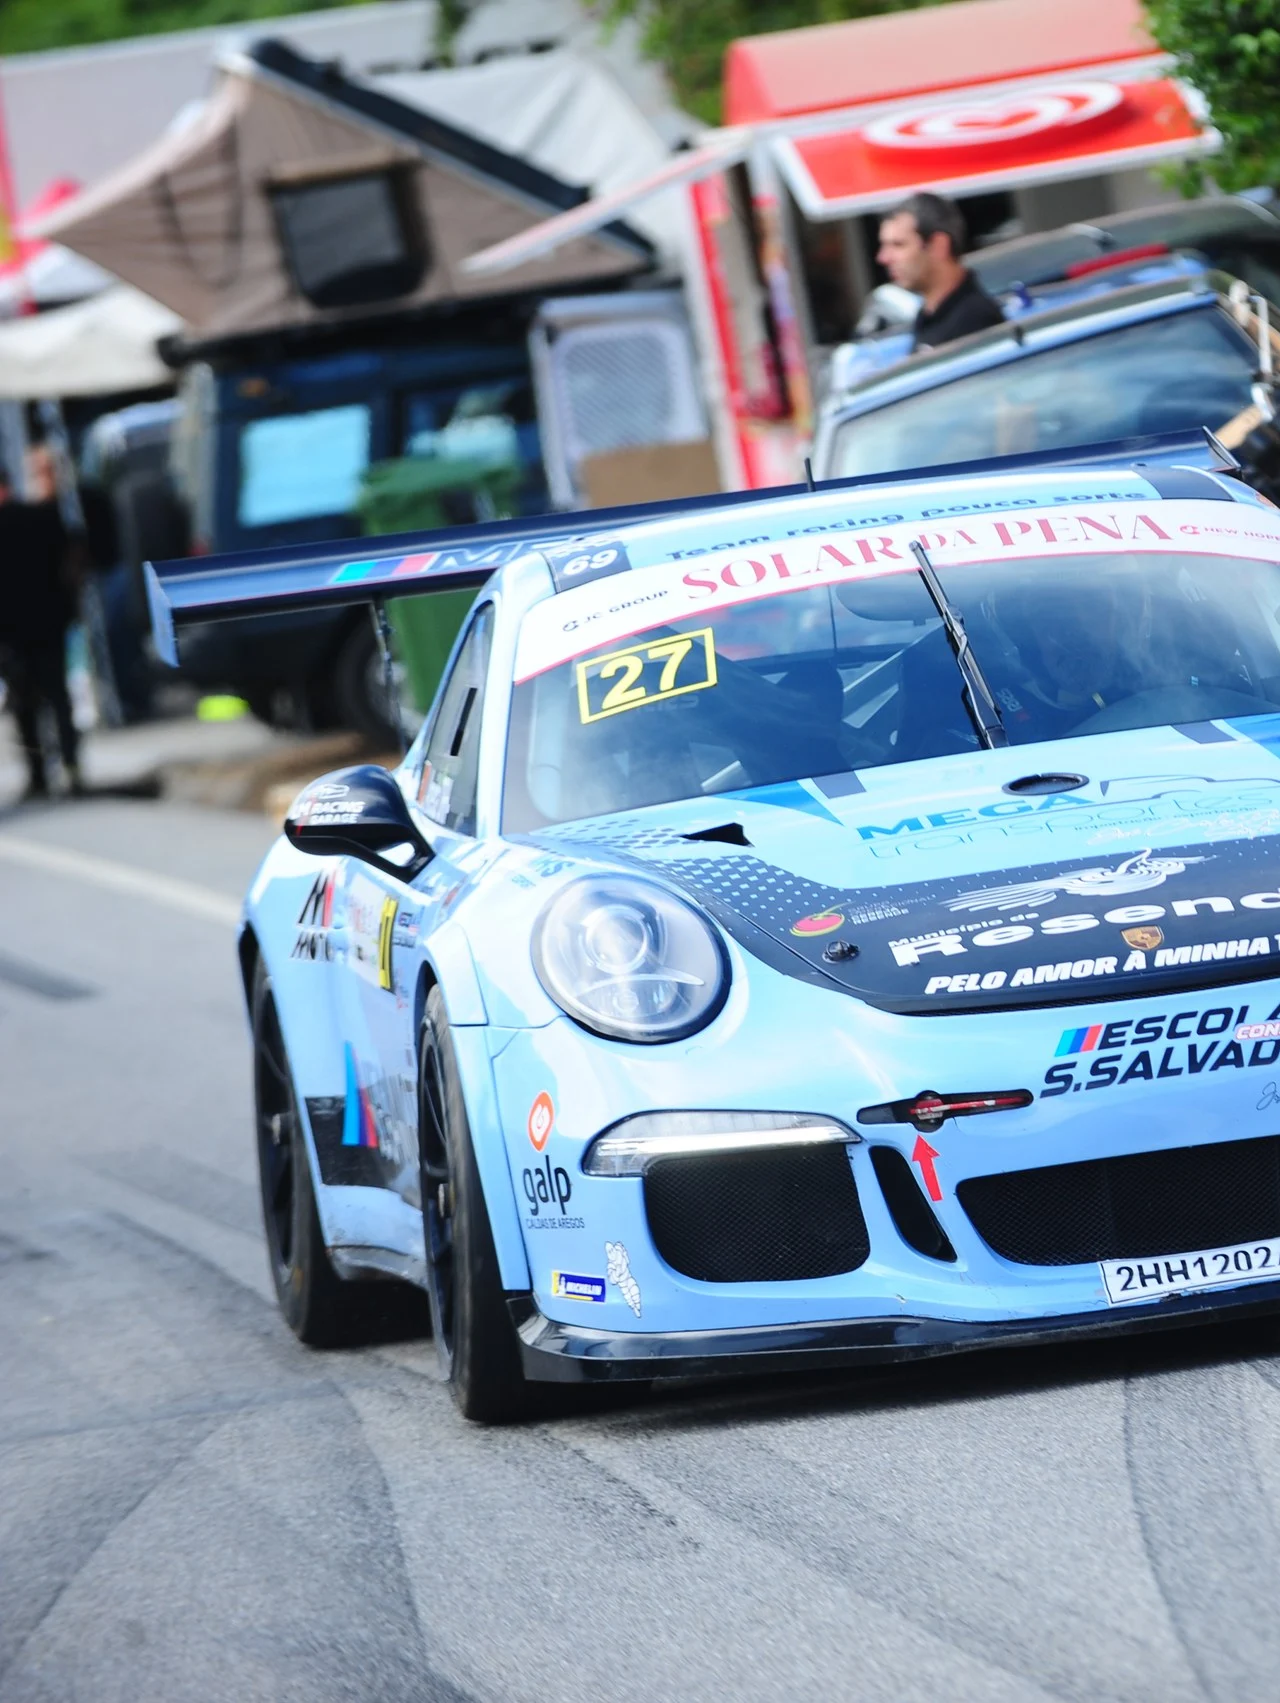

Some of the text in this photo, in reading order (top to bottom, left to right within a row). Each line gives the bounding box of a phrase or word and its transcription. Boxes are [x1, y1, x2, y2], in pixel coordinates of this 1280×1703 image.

[666, 491, 1148, 561] Team racing pouca sorte
[1204, 526, 1238, 535] NEW
[563, 549, 618, 575] 69
[682, 514, 1173, 599] SOLAR DA PENA
[609, 590, 668, 613] GROUP
[601, 639, 693, 710] 27
[312, 801, 366, 814] RACING
[856, 793, 1096, 840] MEGA
[869, 793, 1273, 859] transportes
[924, 970, 1008, 994] PELO
[1010, 955, 1118, 988] AMOR
[1122, 950, 1147, 972] À
[1154, 936, 1271, 968] MINHA
[523, 1154, 571, 1216] galp
